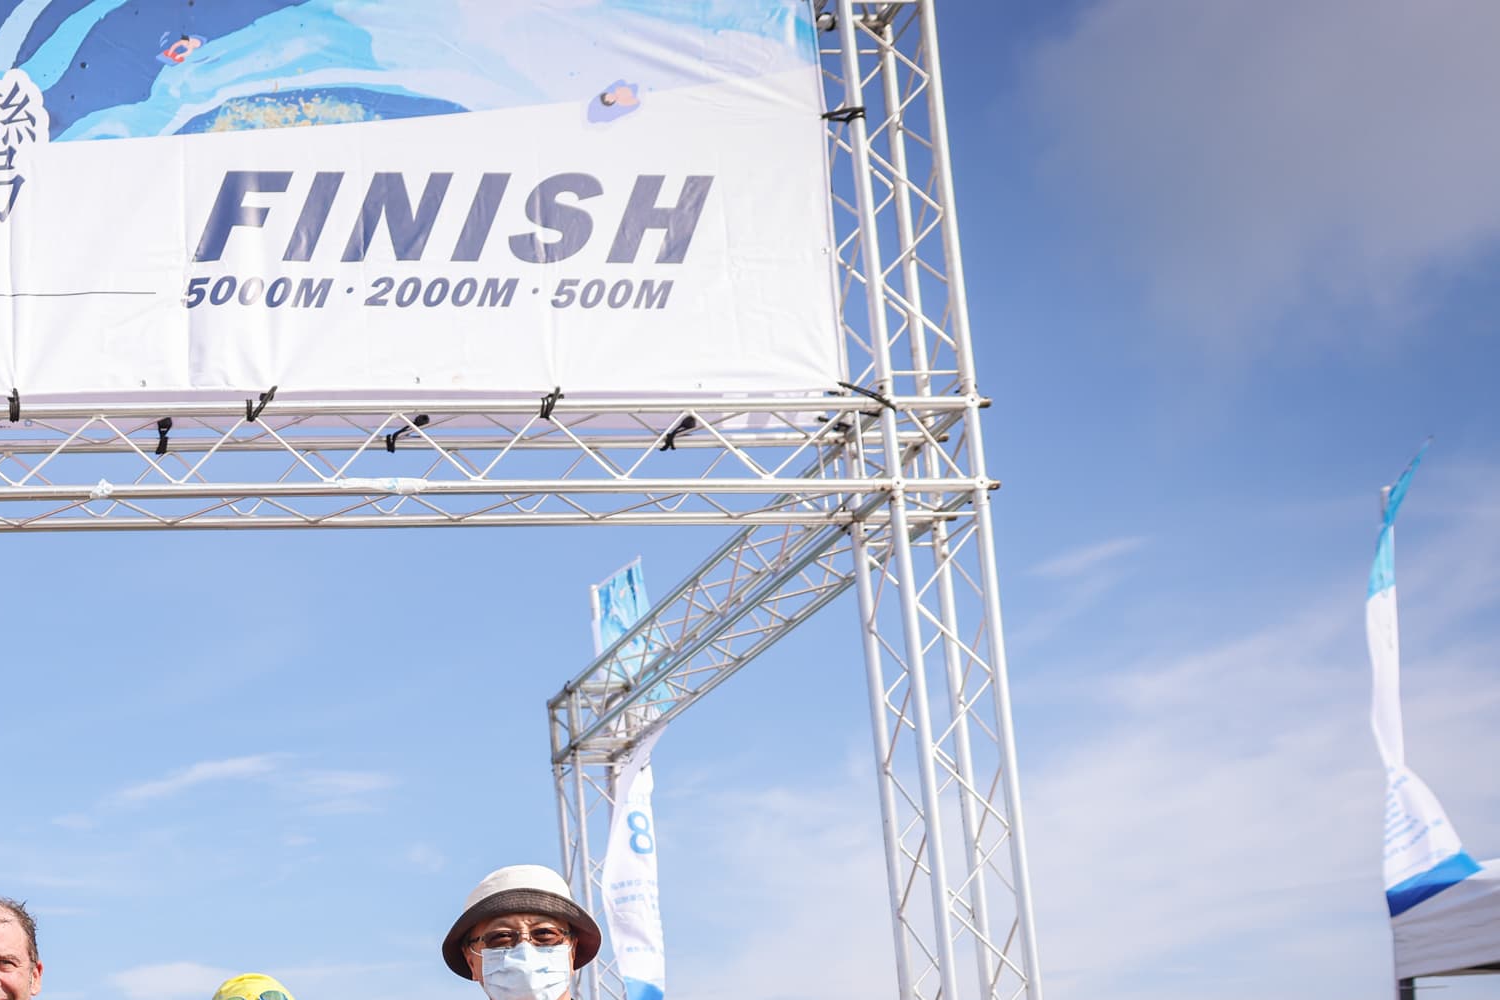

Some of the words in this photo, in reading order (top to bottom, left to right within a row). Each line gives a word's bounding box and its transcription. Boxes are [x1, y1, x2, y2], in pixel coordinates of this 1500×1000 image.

[191, 170, 714, 265] FINISH
[182, 275, 334, 309] 5000M
[364, 276, 520, 309] 2000M
[550, 278, 674, 310] 500M
